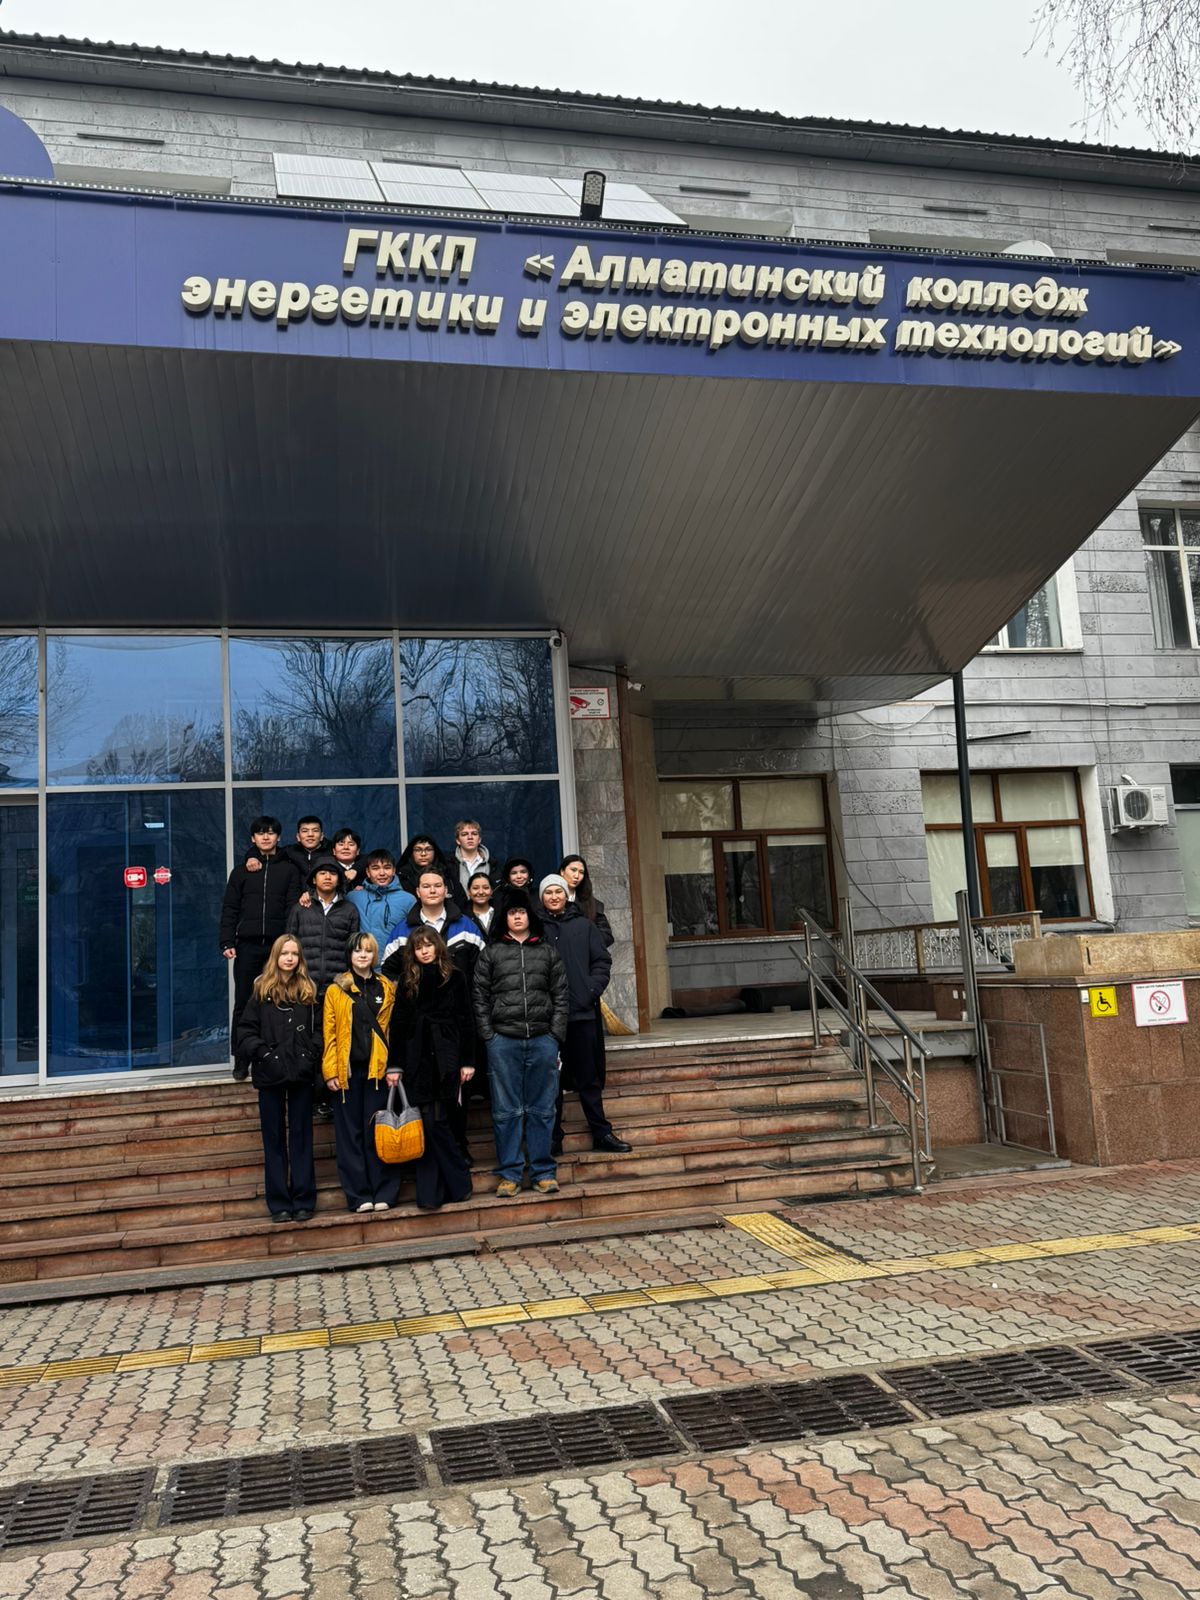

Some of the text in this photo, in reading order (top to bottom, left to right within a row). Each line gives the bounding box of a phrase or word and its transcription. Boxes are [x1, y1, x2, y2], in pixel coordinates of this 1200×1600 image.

[342, 227, 478, 280] ГККП
[905, 275, 1090, 318] колледж
[180, 275, 1183, 363] энергетики и электронных технологий»
